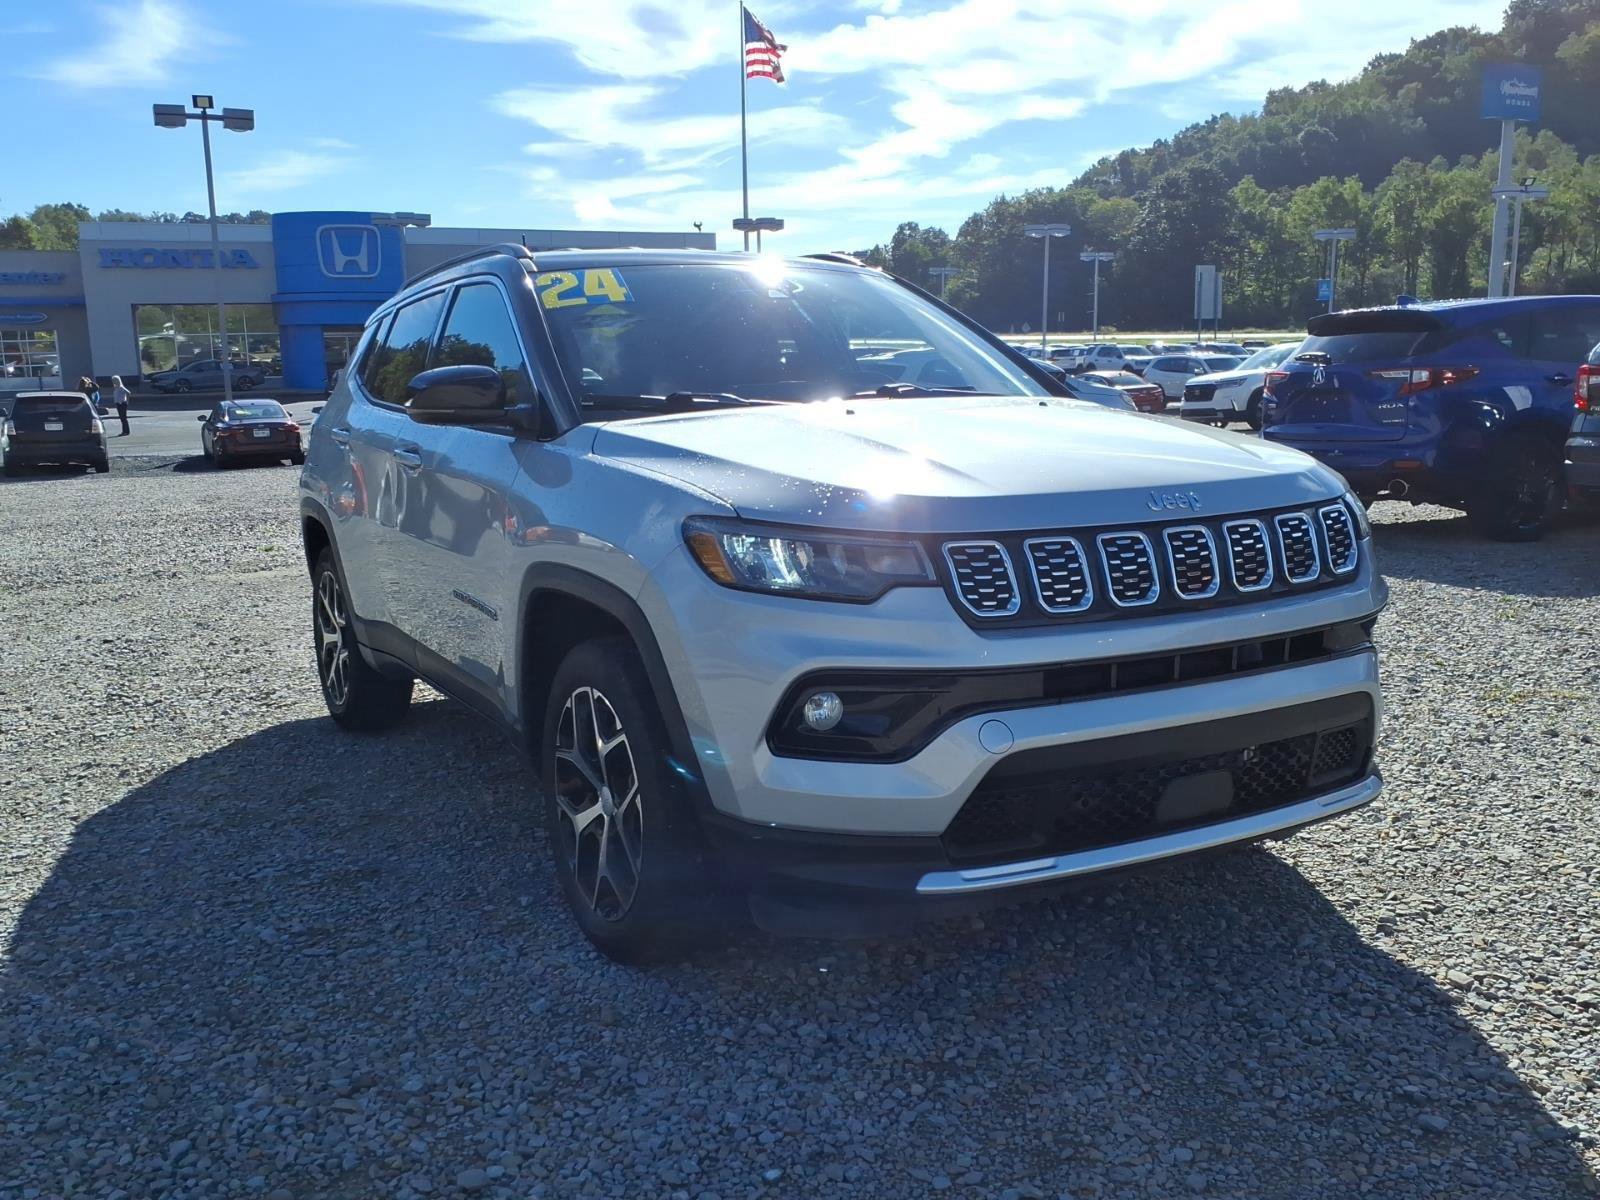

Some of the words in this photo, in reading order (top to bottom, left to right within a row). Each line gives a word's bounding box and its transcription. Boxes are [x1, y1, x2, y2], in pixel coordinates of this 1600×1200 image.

[98, 248, 260, 269] HONDA
[535, 268, 628, 309] 24
[1146, 490, 1202, 513] Jeep
